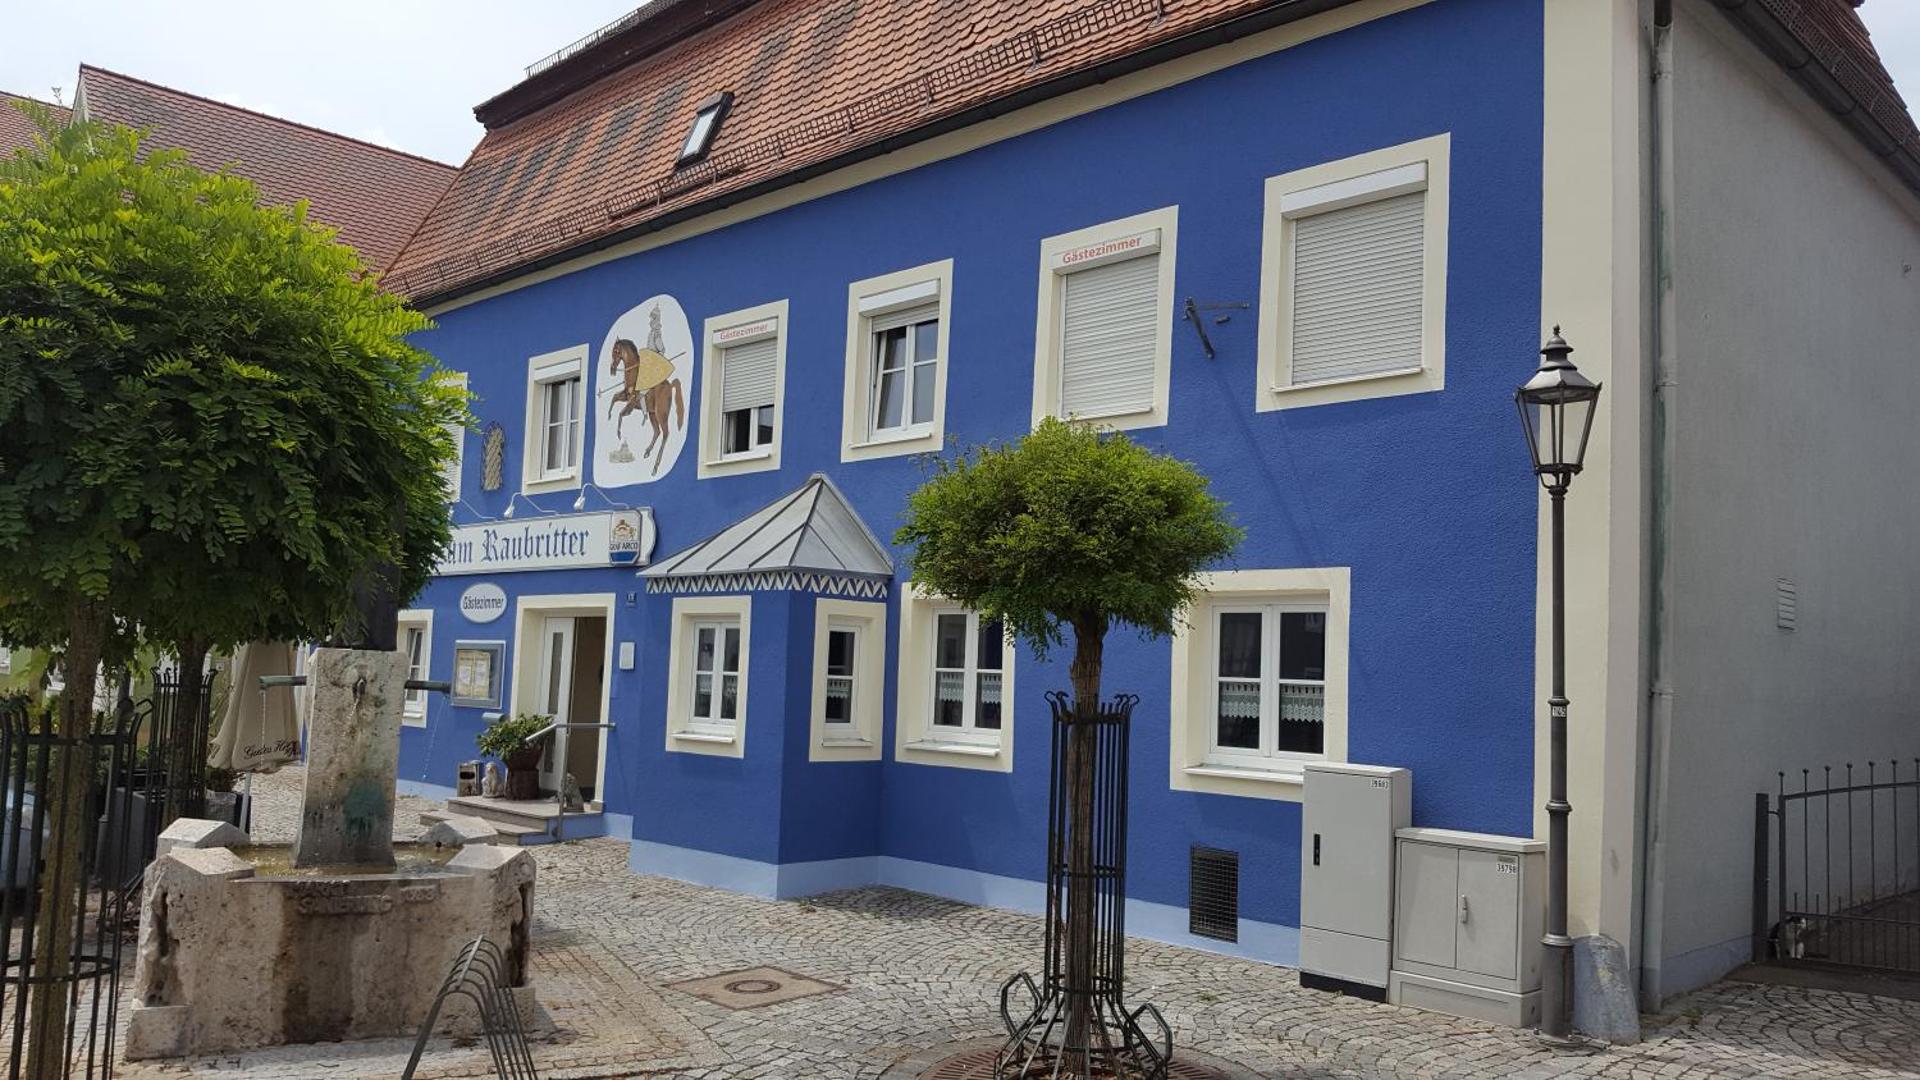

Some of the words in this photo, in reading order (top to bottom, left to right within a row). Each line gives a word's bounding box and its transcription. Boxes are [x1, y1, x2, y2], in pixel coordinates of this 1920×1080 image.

[1062, 236, 1142, 264] Gästezimmer
[720, 323, 769, 340] Gästezimmer
[481, 522, 589, 563] Raubritter
[622, 541, 638, 550] ARCO
[463, 595, 504, 610] Gästezimmer
